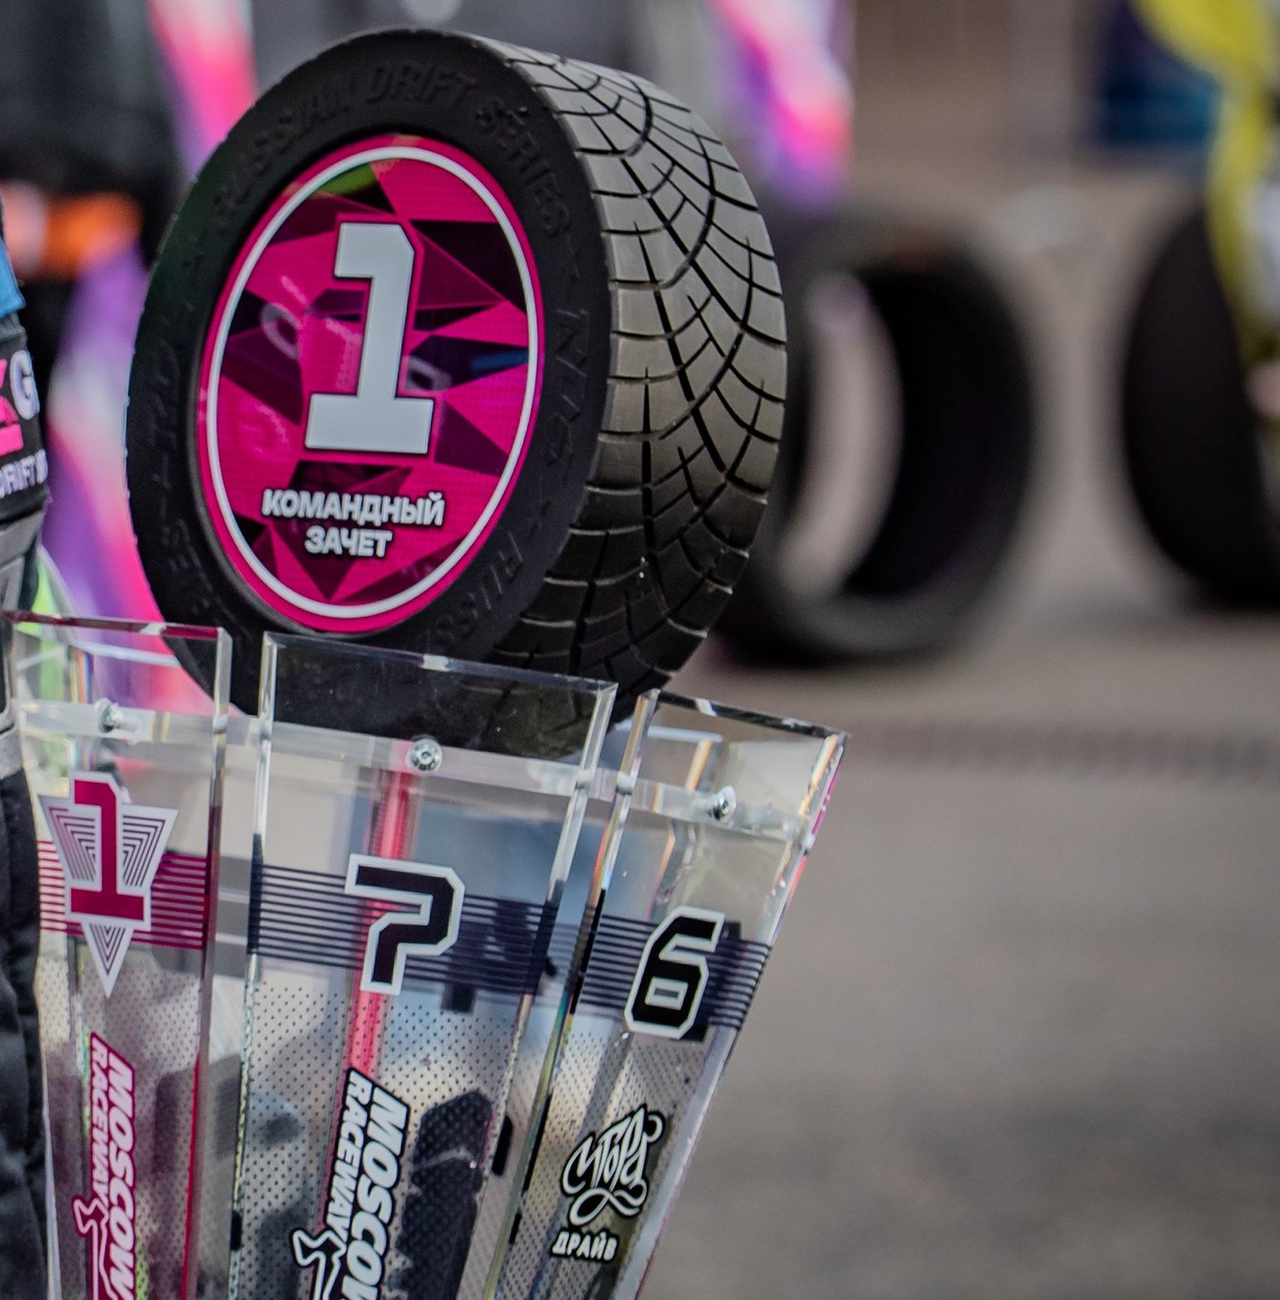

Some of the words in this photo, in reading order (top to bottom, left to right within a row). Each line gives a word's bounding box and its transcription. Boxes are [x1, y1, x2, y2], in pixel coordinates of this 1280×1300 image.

[304, 222, 435, 455] 1
[261, 488, 446, 527] КОМАНДНЫЙ
[304, 525, 393, 558] ЗАЧЕТ
[68, 776, 147, 925] 1
[349, 859, 462, 991] 7
[627, 910, 721, 1035] 6
[90, 1035, 110, 1208] RACEWAY
[325, 1069, 373, 1244] RACEWAY
[551, 1230, 619, 1262] ДРАЙВ
